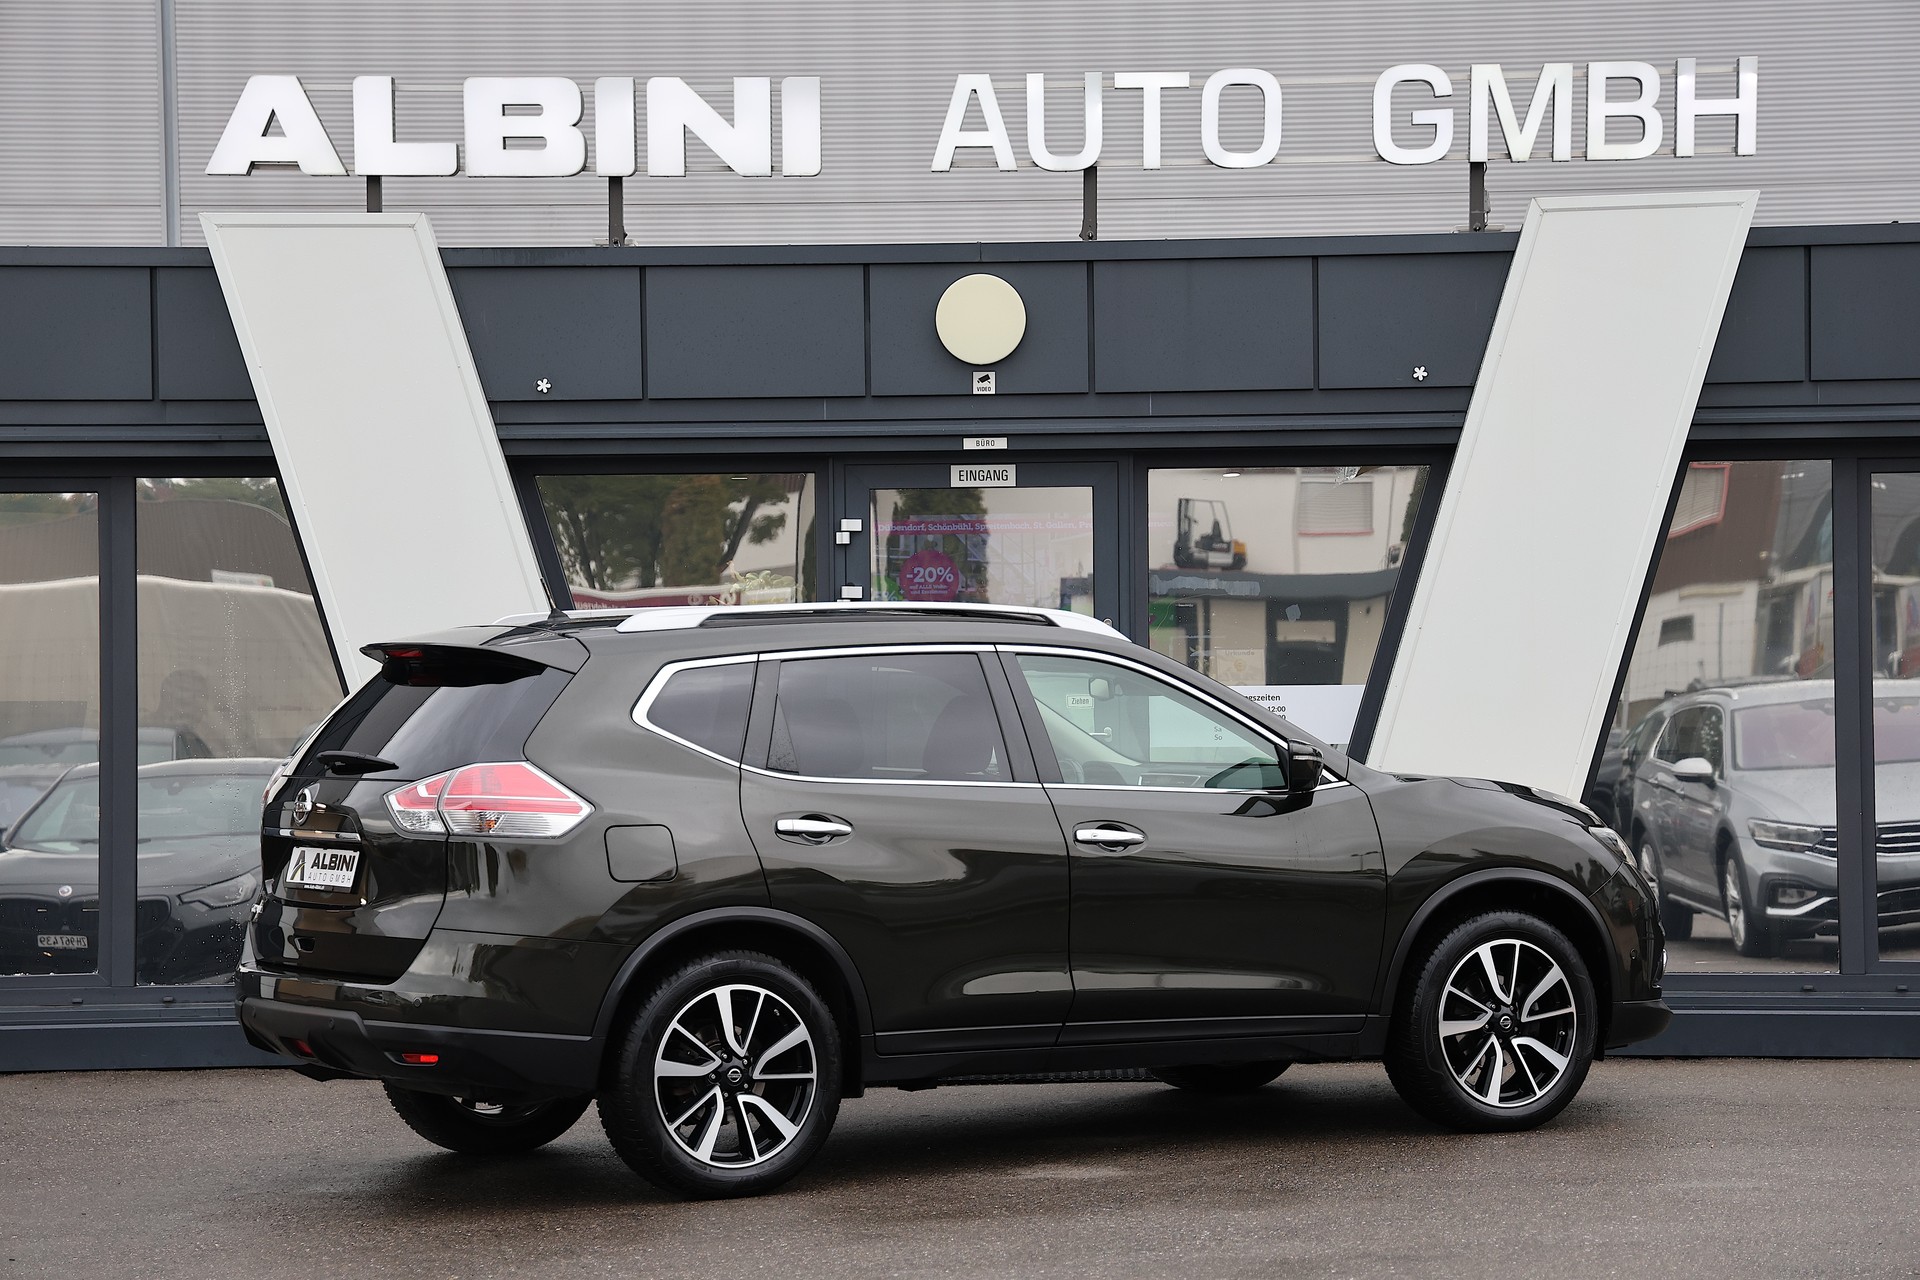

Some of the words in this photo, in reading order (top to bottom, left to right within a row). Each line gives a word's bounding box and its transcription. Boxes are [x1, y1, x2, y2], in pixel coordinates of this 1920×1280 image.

[205, 75, 822, 177] ALBINI
[931, 68, 1283, 172] AUTO
[1372, 56, 1759, 164] GMBH
[975, 439, 995, 447] BÜRO
[958, 469, 1009, 482] EINGANG
[906, 566, 954, 583] -20%
[1225, 648, 1255, 656] Urkunde
[1071, 697, 1090, 705] Ziehen
[311, 852, 356, 872] ALBINI
[308, 872, 327, 882] AUTO
[330, 873, 352, 883] GMBH
